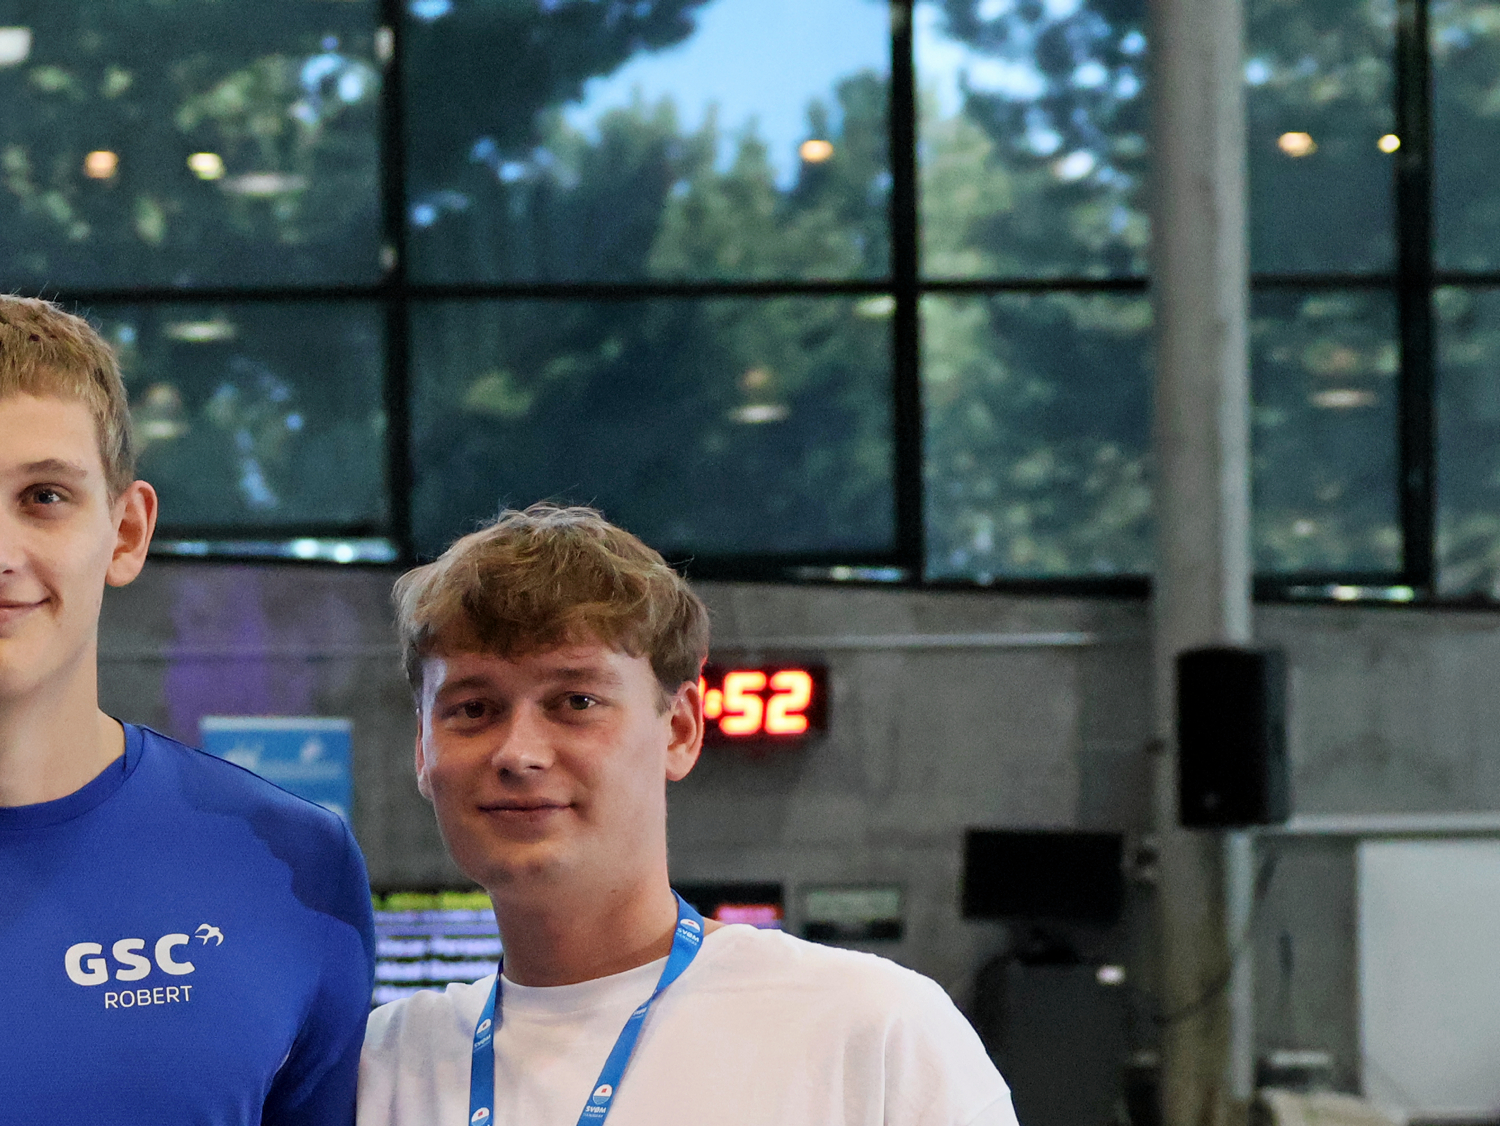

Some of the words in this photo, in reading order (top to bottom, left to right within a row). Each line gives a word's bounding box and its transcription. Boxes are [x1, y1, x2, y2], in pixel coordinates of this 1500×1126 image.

[698, 669, 814, 736] :52
[64, 933, 196, 986] GSC
[104, 985, 193, 1009] ROBERT
